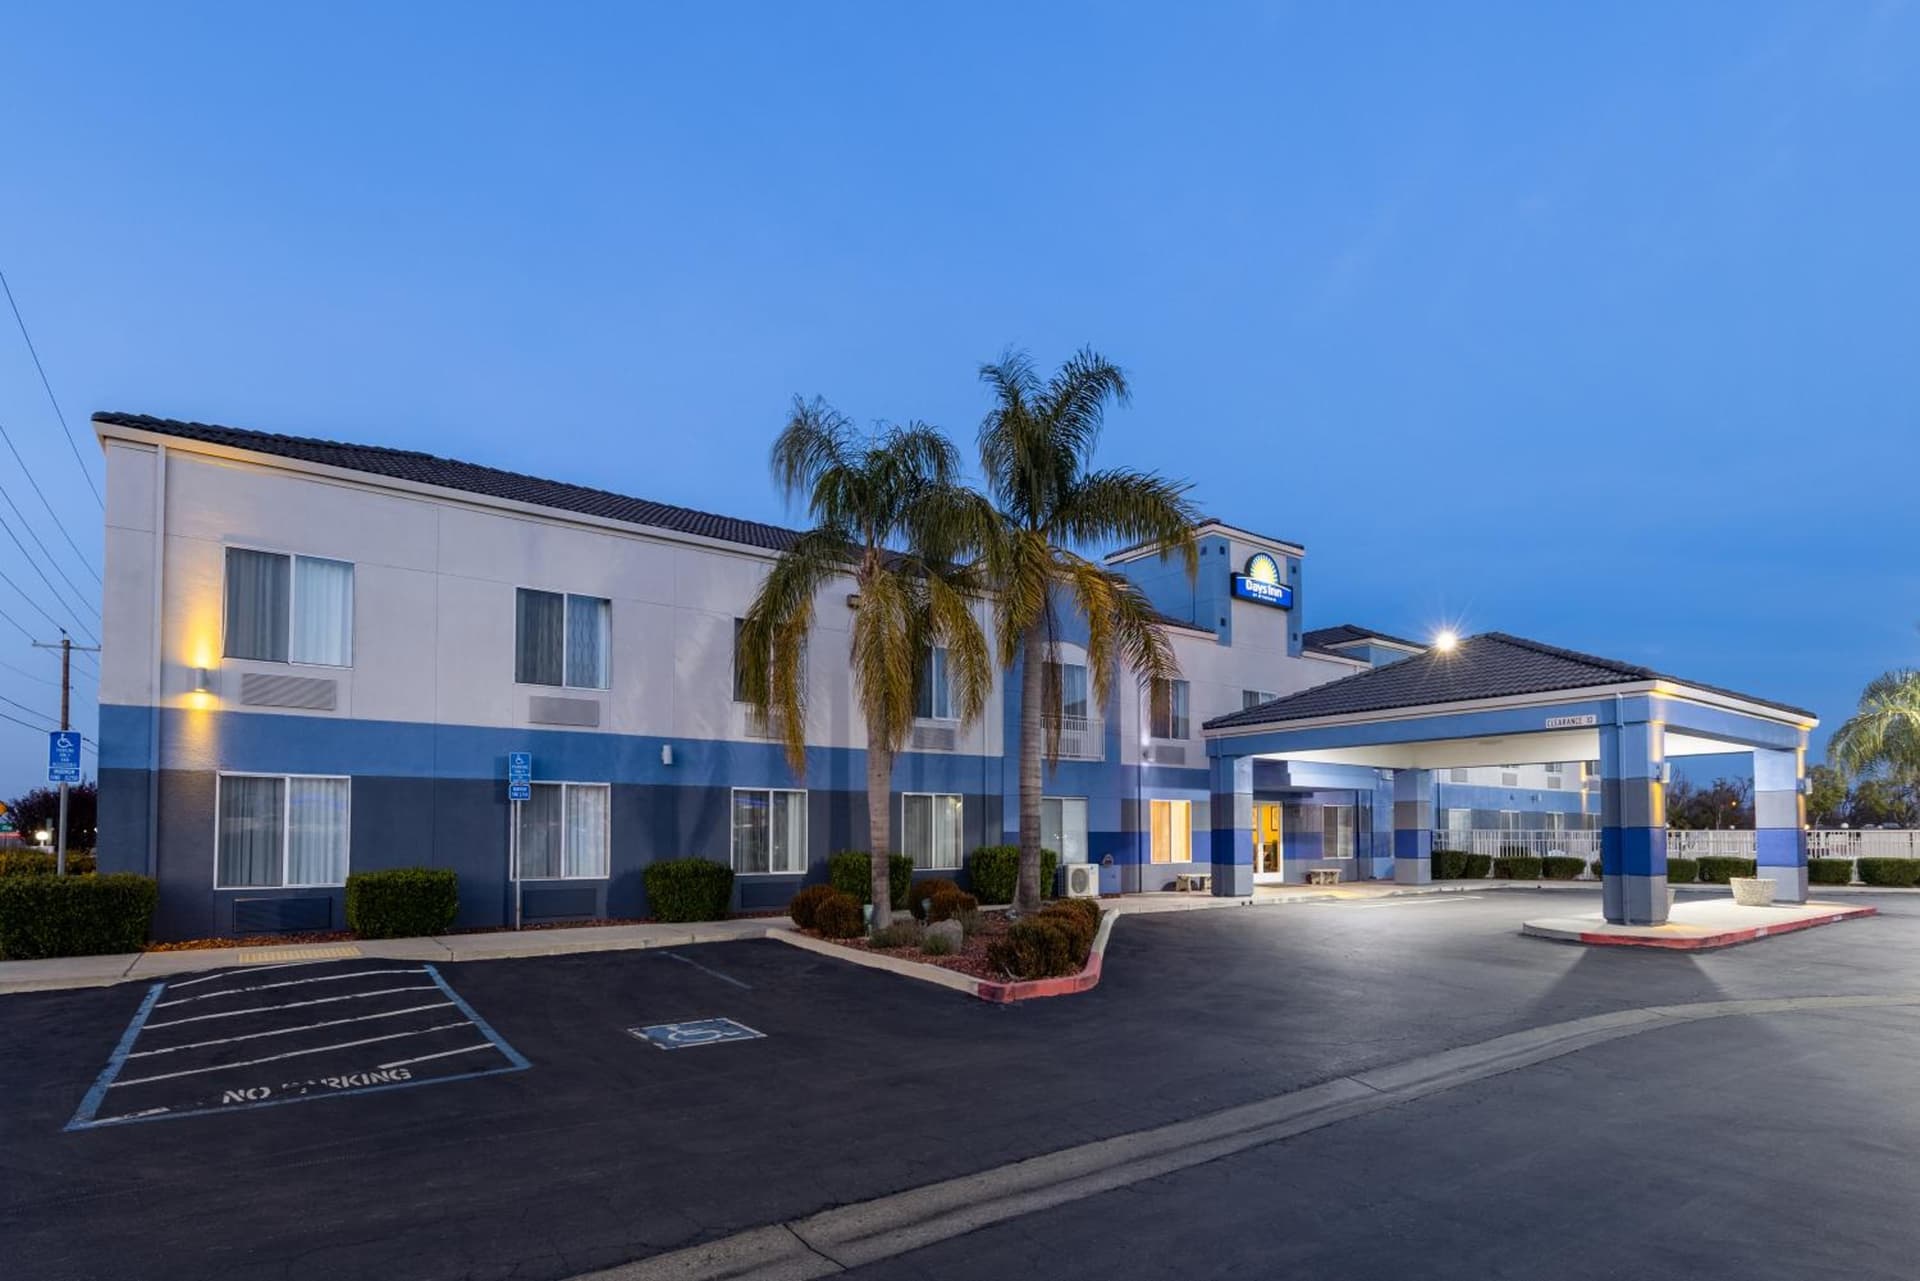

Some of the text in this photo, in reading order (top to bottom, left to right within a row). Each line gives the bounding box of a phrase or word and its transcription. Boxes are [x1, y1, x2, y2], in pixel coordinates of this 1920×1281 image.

[1246, 580, 1267, 594] Days
[1268, 585, 1282, 598] Inn
[1547, 717, 1583, 727] CLEARANCE
[223, 1068, 412, 1104] NO RKING
